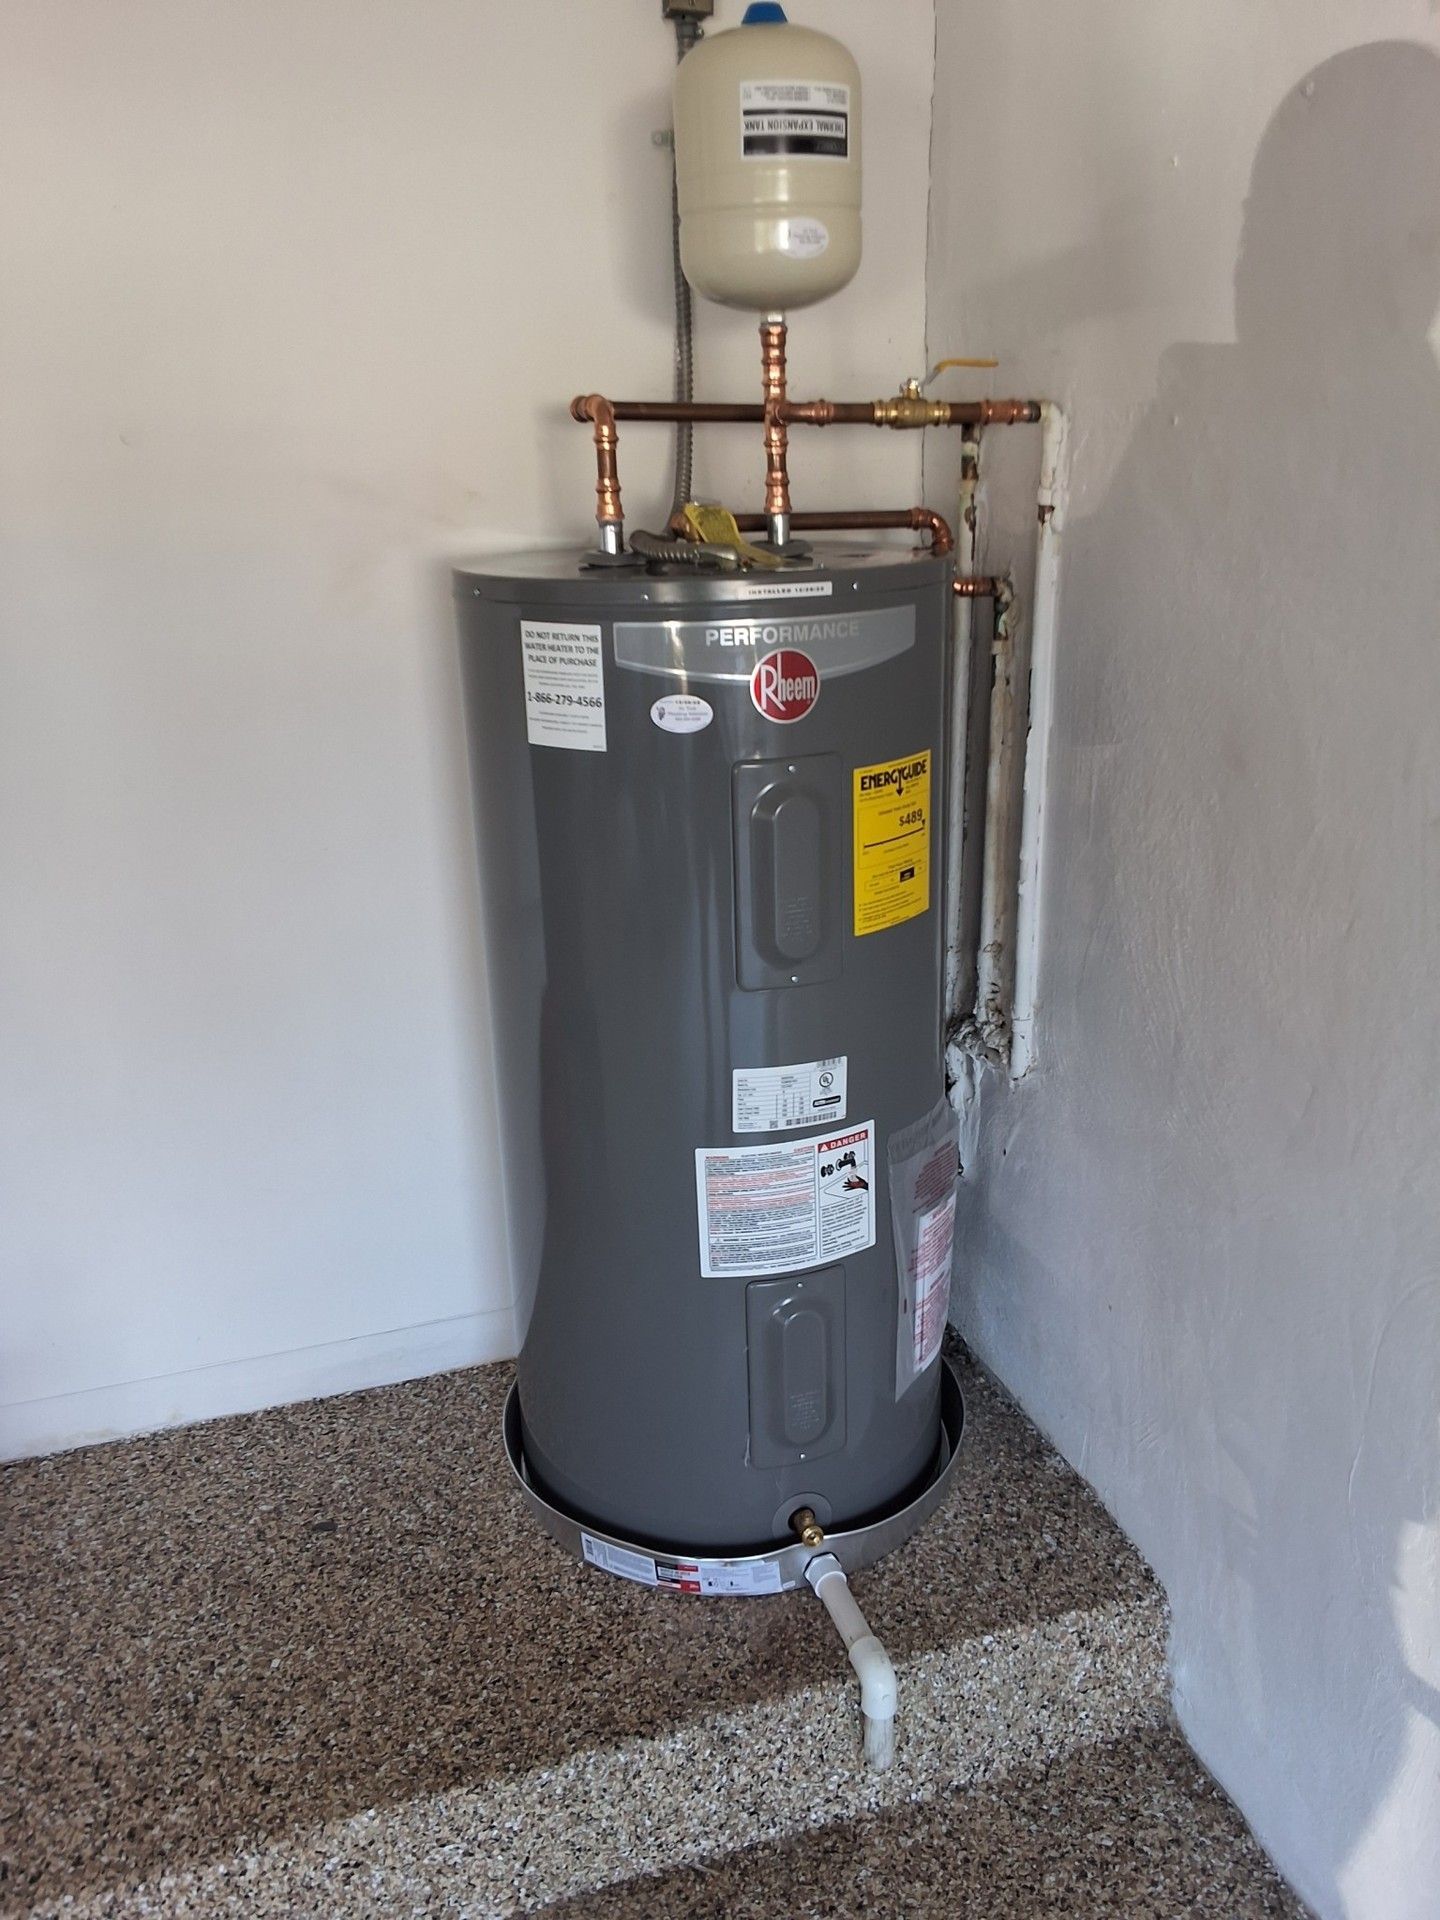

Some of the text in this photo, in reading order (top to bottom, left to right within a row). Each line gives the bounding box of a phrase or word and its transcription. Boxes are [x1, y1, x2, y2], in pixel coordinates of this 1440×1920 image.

[744, 118, 844, 133] THERMAL EXPANSION TANK
[524, 630, 599, 643] DO NOT RETURN THIS
[706, 621, 859, 646] PERFORMANCE
[525, 642, 599, 654] WATER HEATER TO THE
[527, 653, 597, 667] PLACE OF PURCHASE
[760, 653, 815, 712] Rheem
[527, 691, 603, 707] 1-866-279-4566
[861, 759, 928, 793] ENERGYGUIDE
[830, 1131, 868, 1149] DANGER
